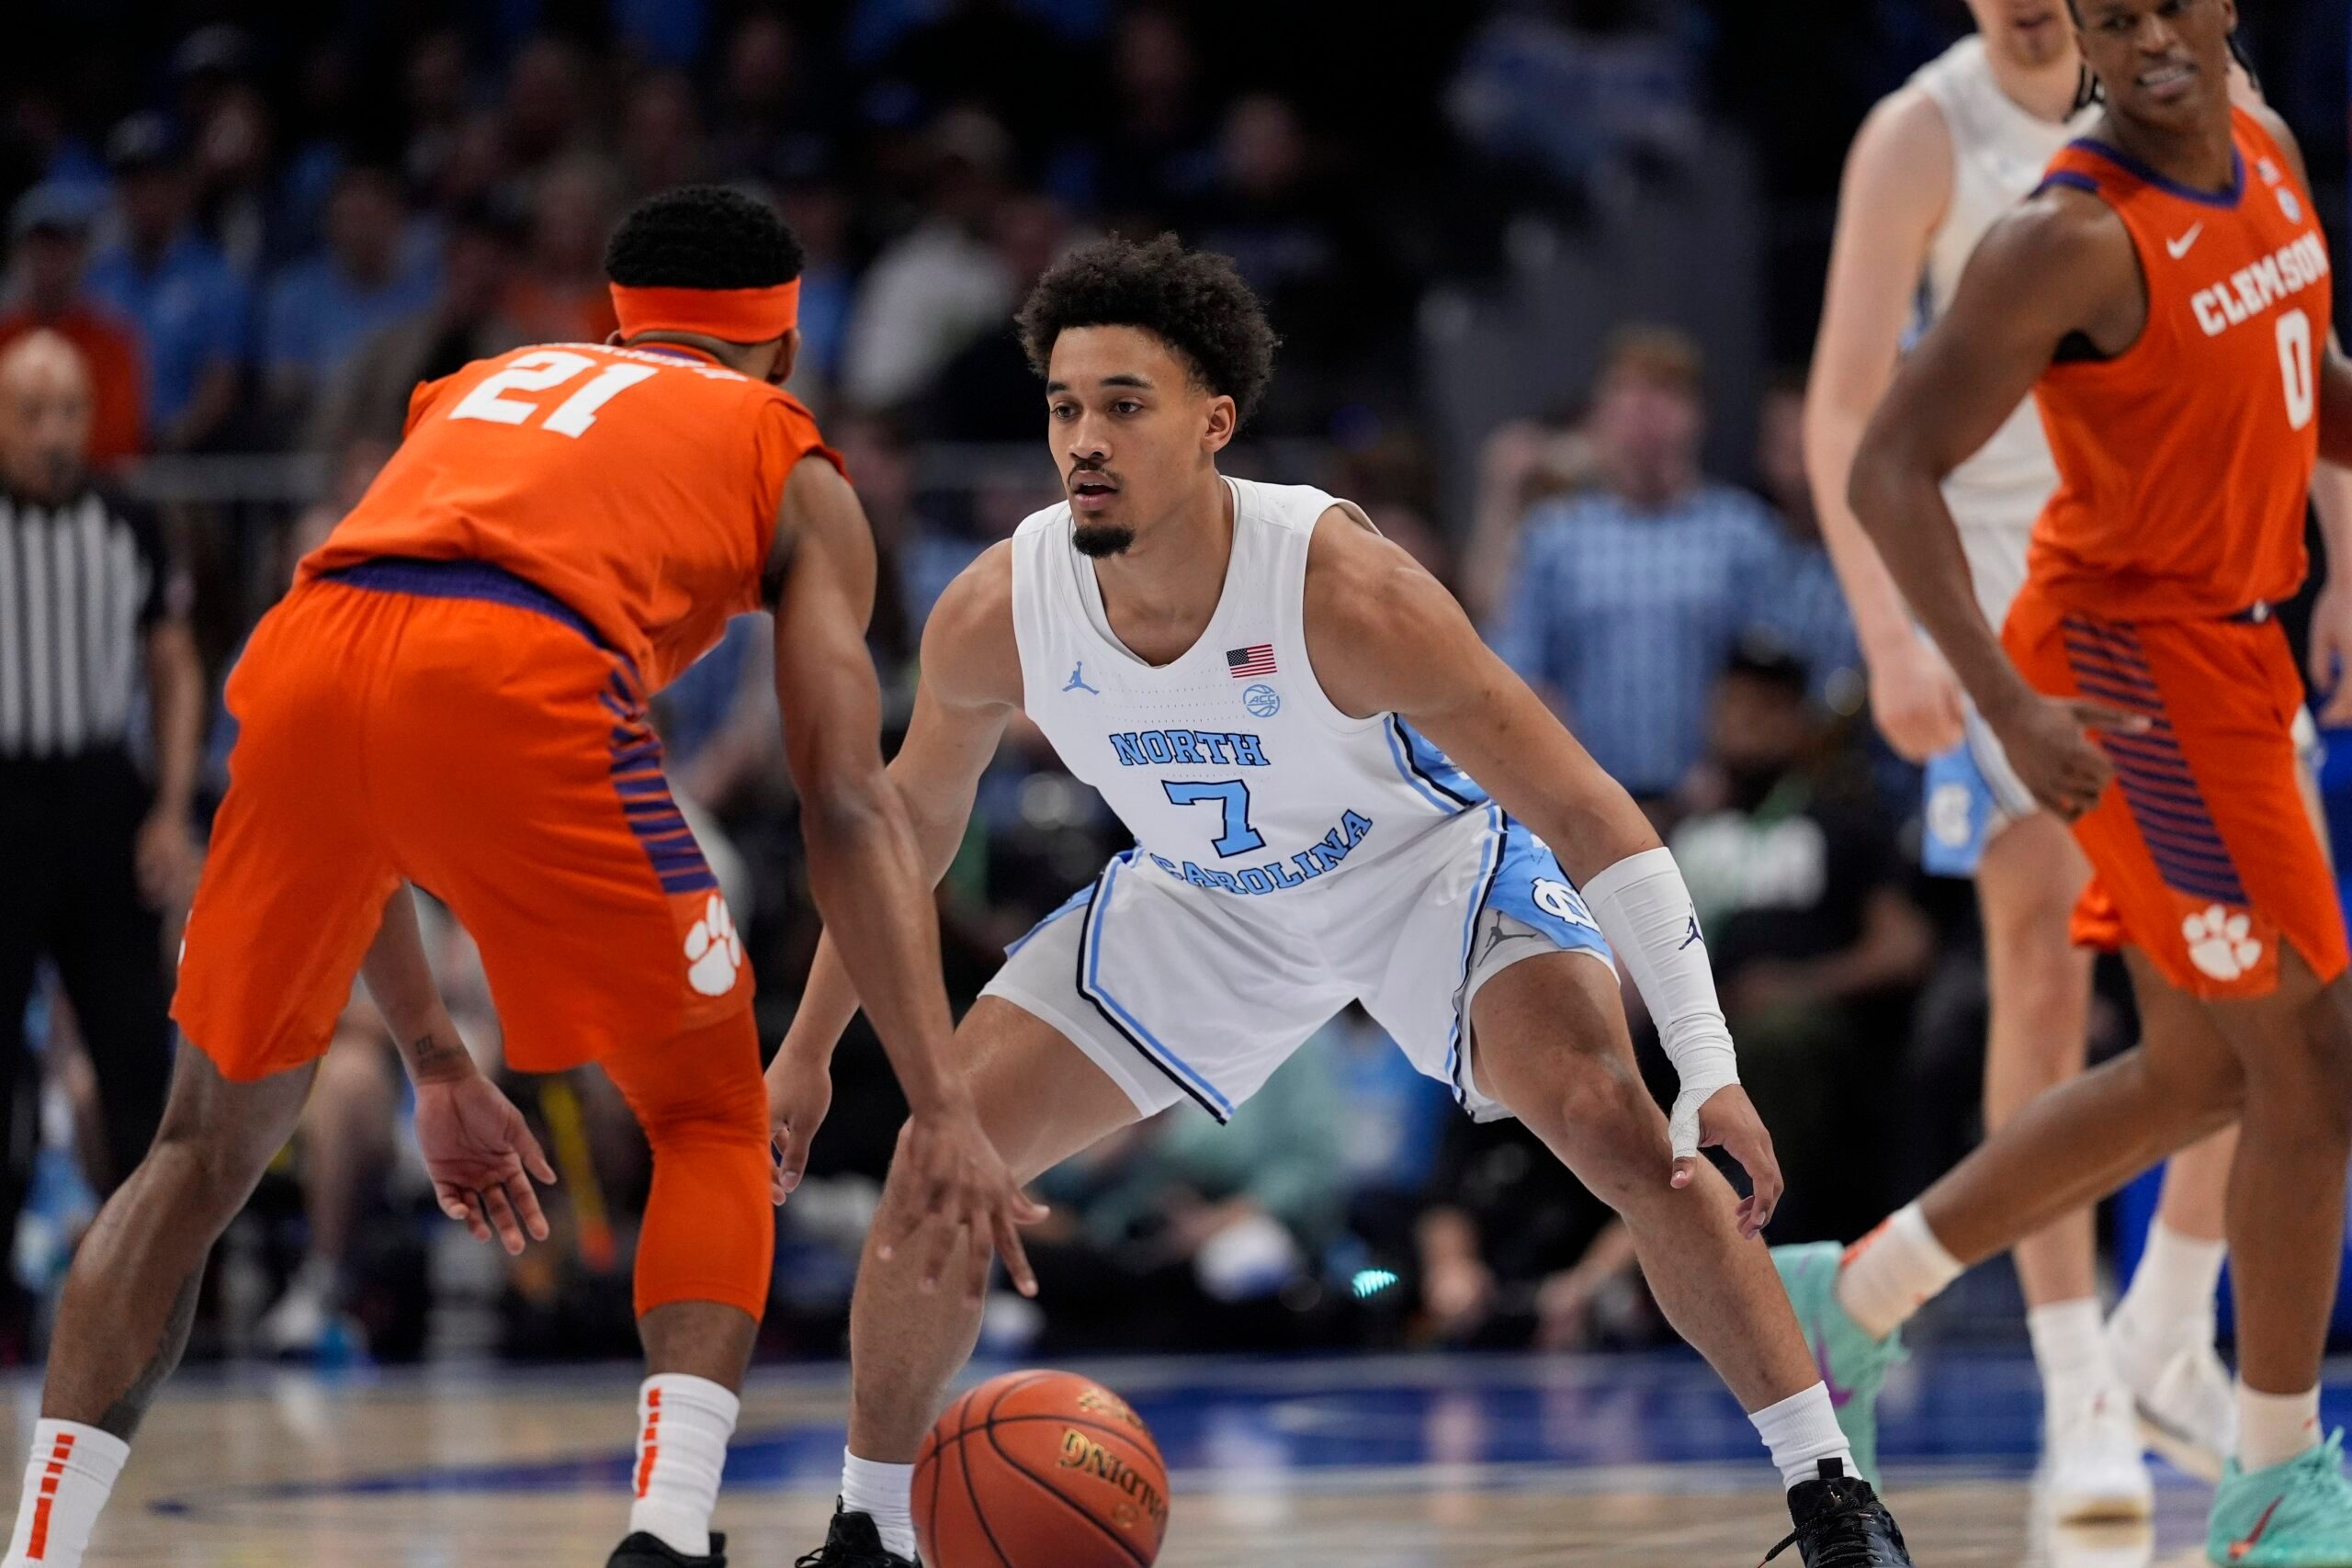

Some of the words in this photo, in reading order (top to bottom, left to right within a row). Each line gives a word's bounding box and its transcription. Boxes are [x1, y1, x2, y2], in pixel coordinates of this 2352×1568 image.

[2191, 231, 2329, 336] CLEMSON
[448, 351, 659, 438] 21
[2276, 308, 2313, 431] 0
[1109, 729, 1271, 766] NORTH
[1149, 809, 1374, 896] CAROLINA
[1161, 779, 1266, 858] 7
